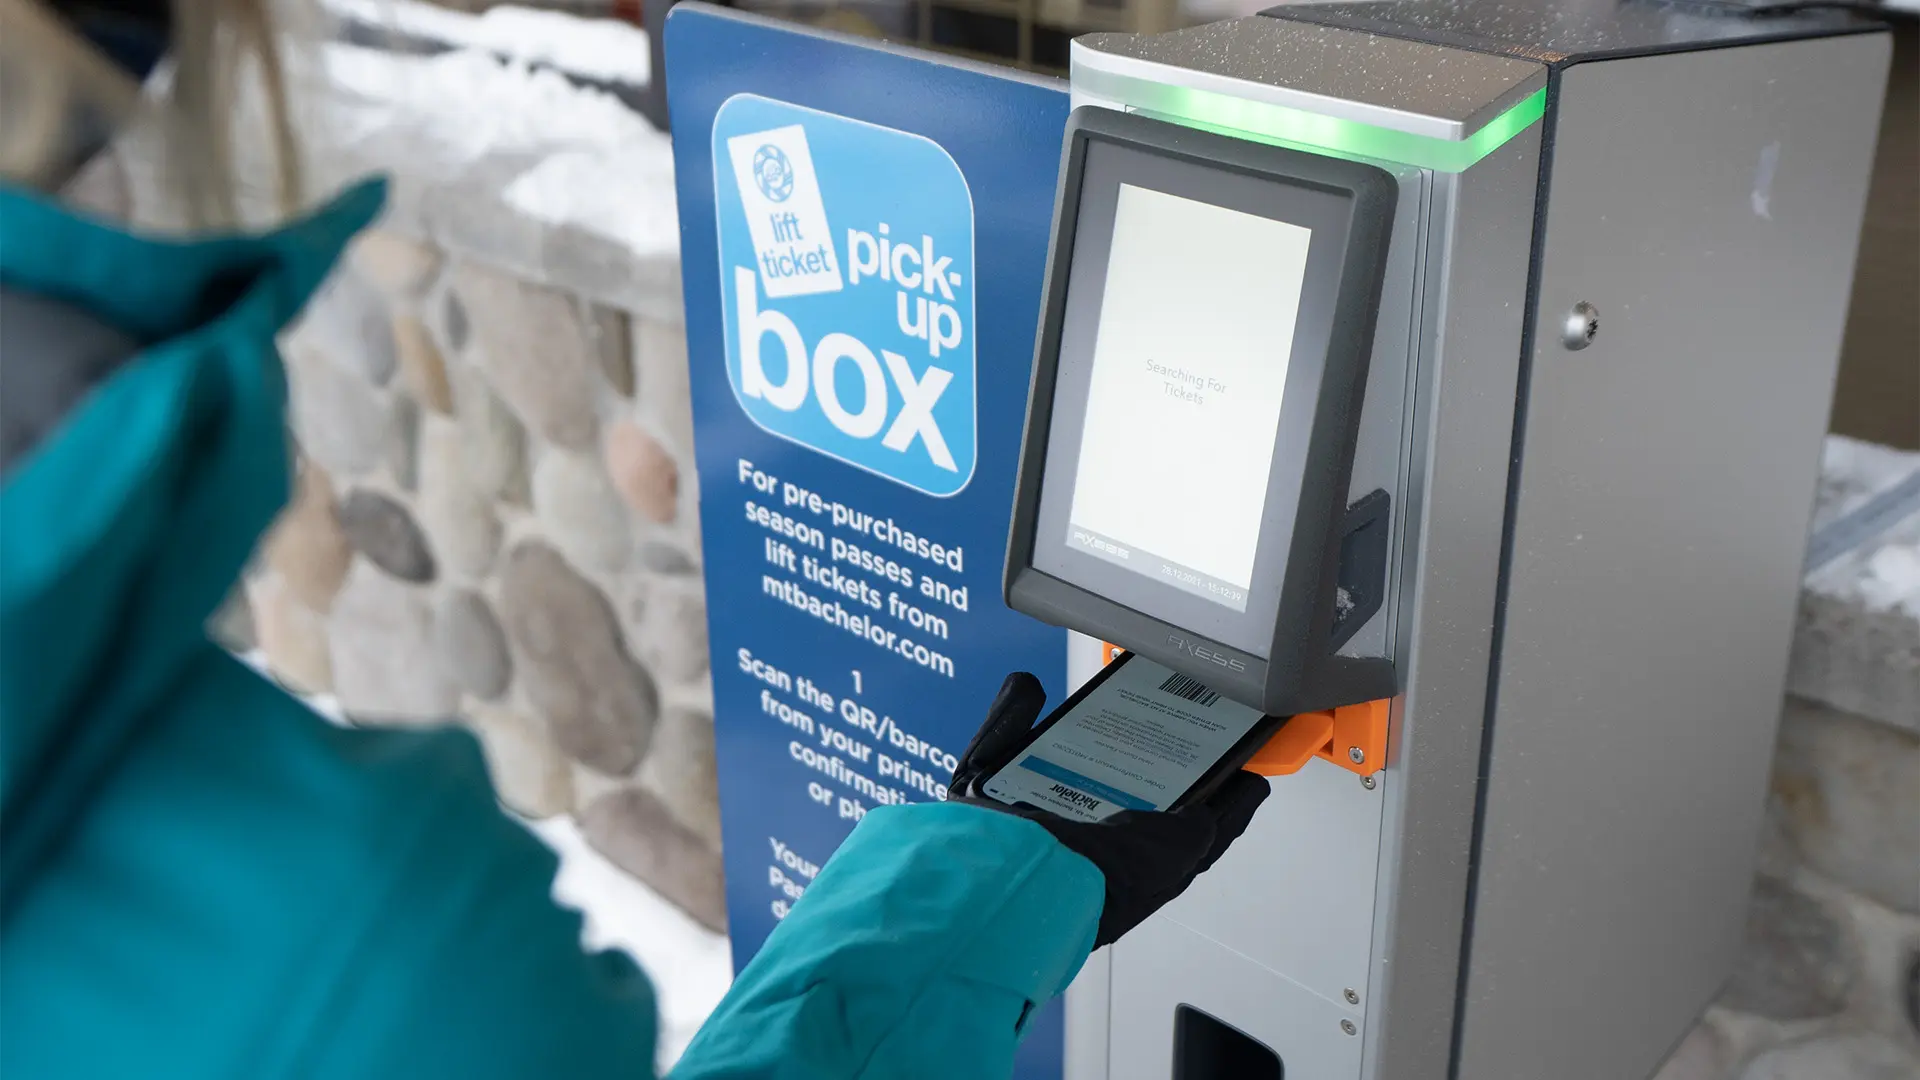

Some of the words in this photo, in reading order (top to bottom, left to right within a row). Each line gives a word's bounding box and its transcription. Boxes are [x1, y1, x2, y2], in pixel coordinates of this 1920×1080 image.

[770, 212, 803, 243] lift
[761, 244, 831, 279] ticket
[848, 222, 961, 300] pick-
[897, 291, 963, 358] up
[735, 266, 959, 473] box
[1146, 358, 1204, 390] Searching
[1207, 377, 1228, 393] For
[1163, 381, 1204, 405] Tickets
[738, 458, 777, 495] For
[783, 481, 963, 573] pre-purchased
[745, 501, 825, 550] season
[831, 536, 913, 588] passes
[920, 575, 968, 612] and
[1073, 531, 1129, 560] AXESS
[765, 537, 797, 573] lift
[802, 554, 882, 610] tickets
[888, 592, 948, 640] from
[762, 574, 955, 678] mtbachelor.com
[1167, 633, 1246, 673] AXESS
[737, 647, 791, 692] Scan
[797, 676, 834, 713] the
[852, 670, 863, 694] 1
[760, 690, 814, 735] from
[819, 723, 872, 763] your
[789, 741, 917, 805] confirmati
[1093, 758, 1143, 781] Confirmation
[1142, 778, 1166, 790] Order
[809, 781, 834, 805] or
[1046, 782, 1101, 810] Bachelor
